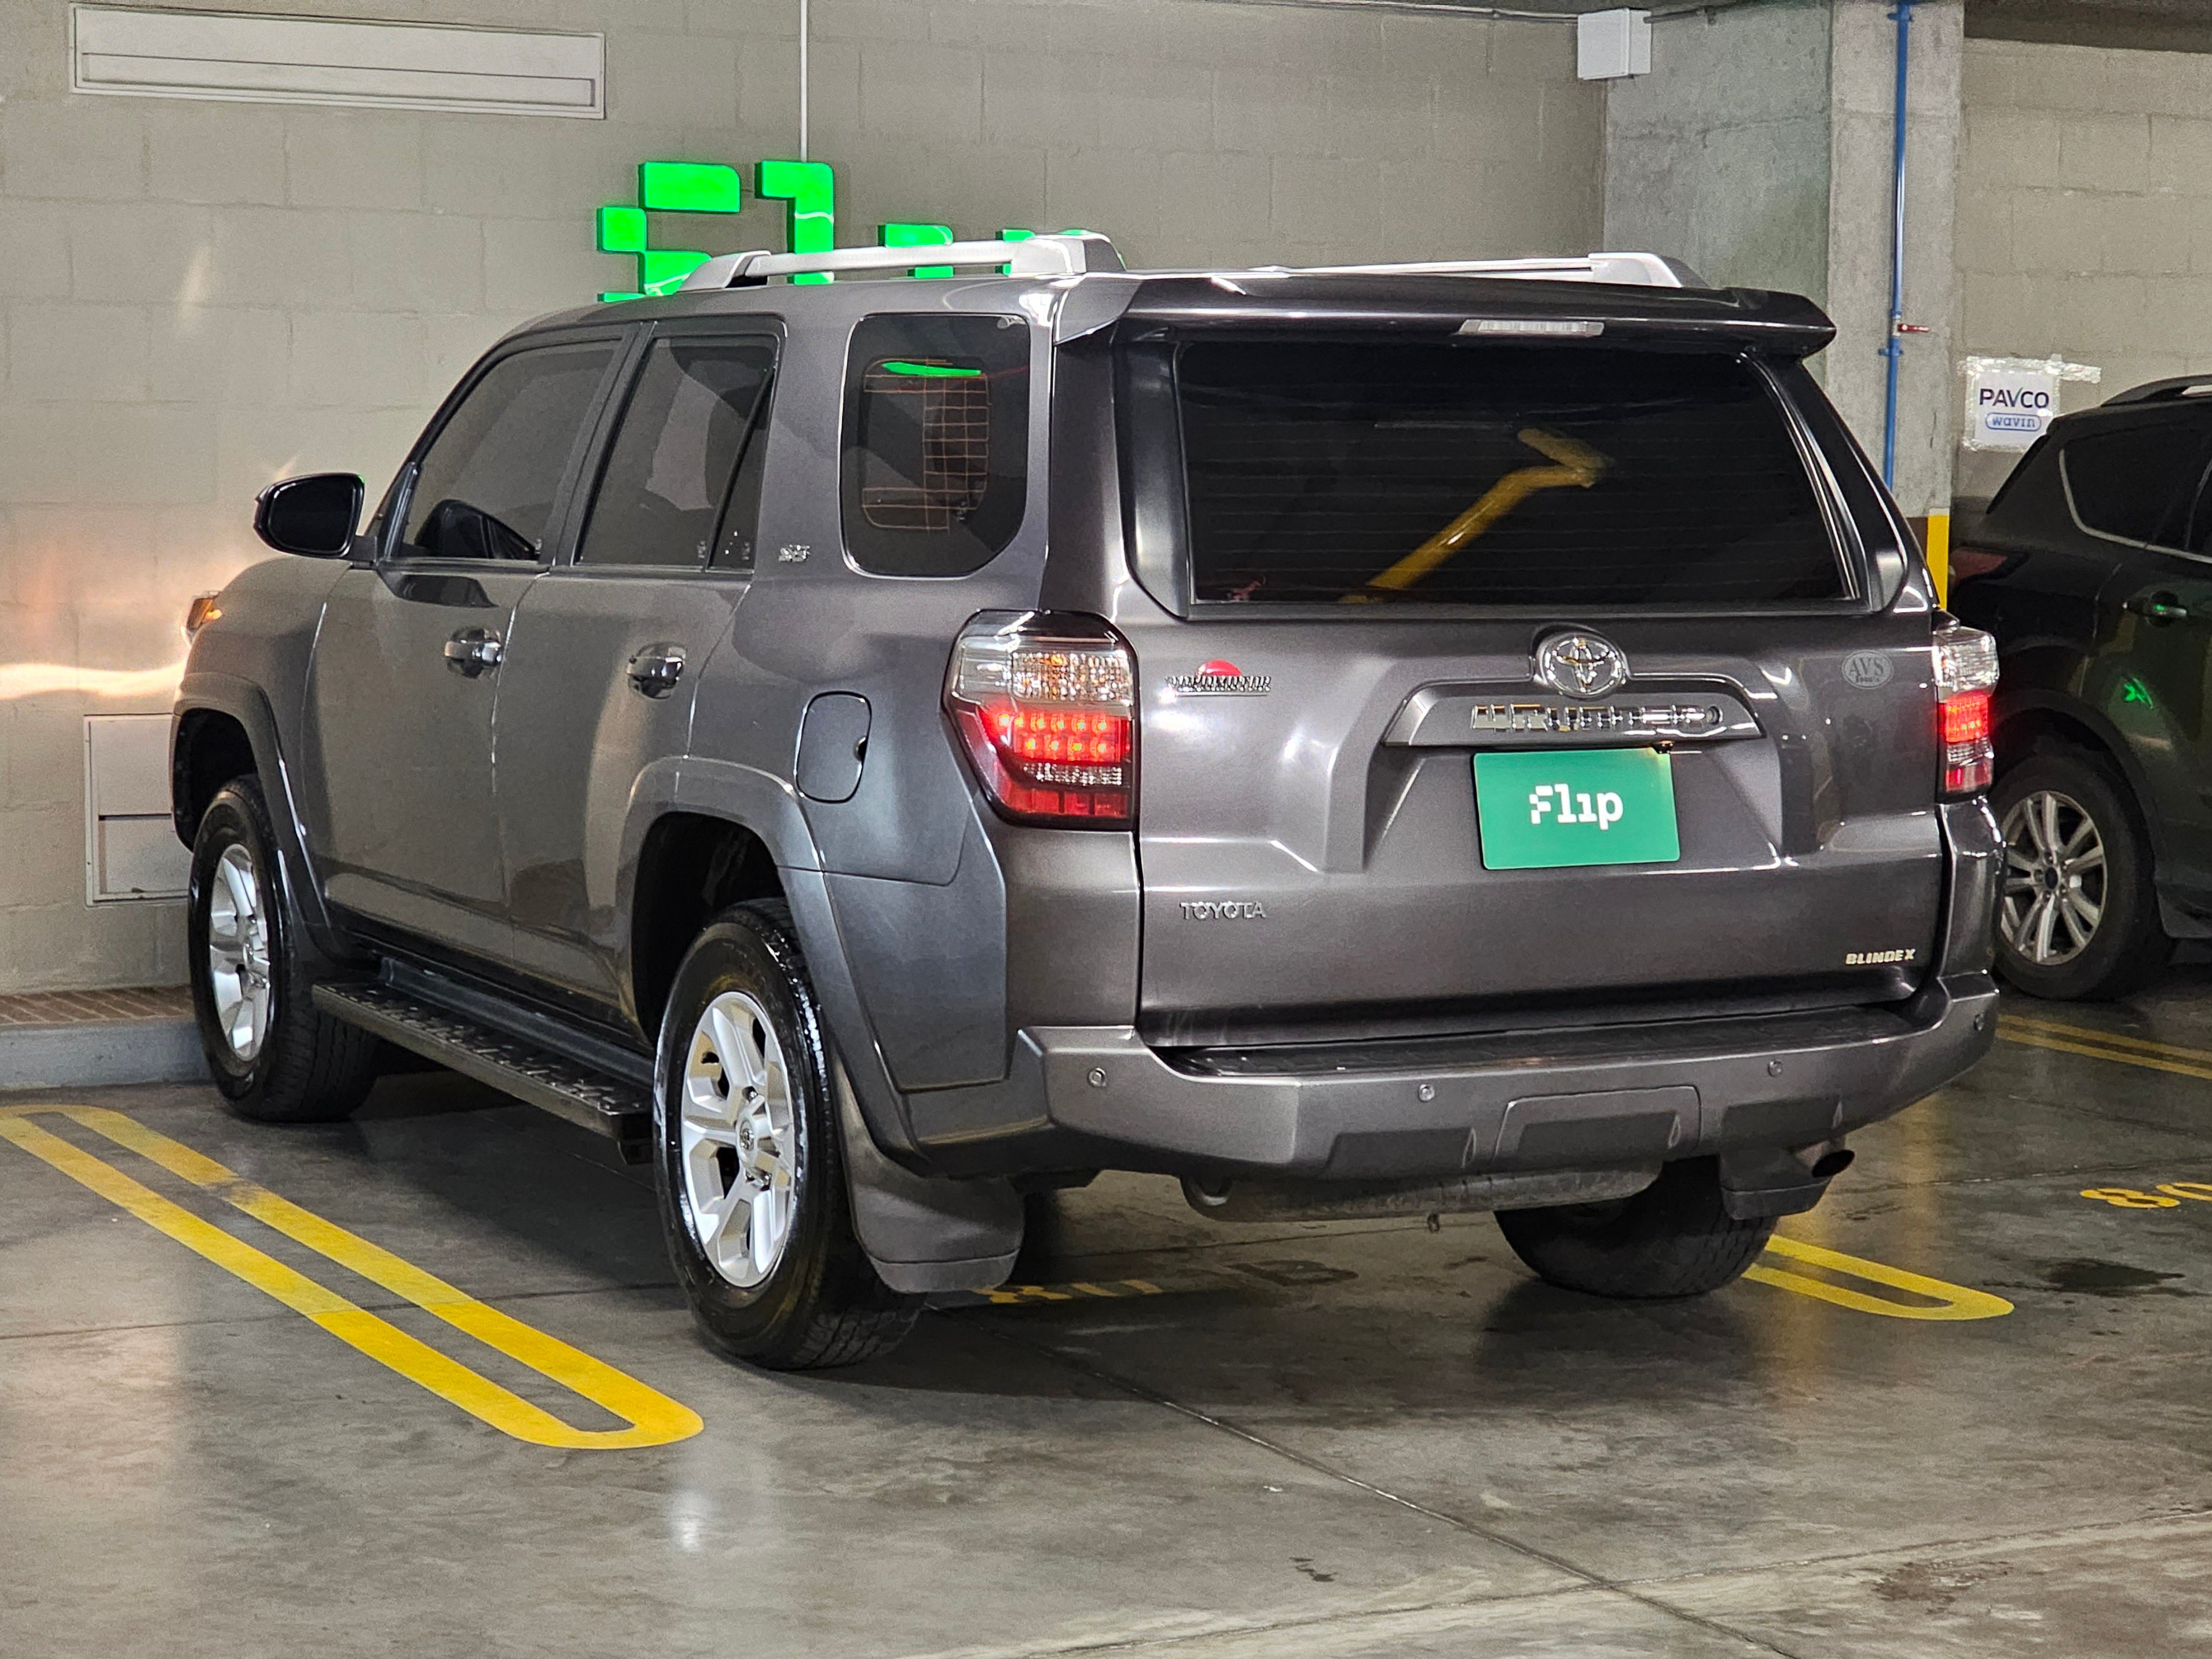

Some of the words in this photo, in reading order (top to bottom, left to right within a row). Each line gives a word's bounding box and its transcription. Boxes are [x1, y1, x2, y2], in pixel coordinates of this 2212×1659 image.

[1979, 387, 2049, 409] PAVCO
[1992, 416, 2035, 428] wavin
[1529, 783, 1624, 830] Flip
[1180, 900, 1266, 920] TOYOTA
[1845, 948, 1916, 965] BLINDEX
